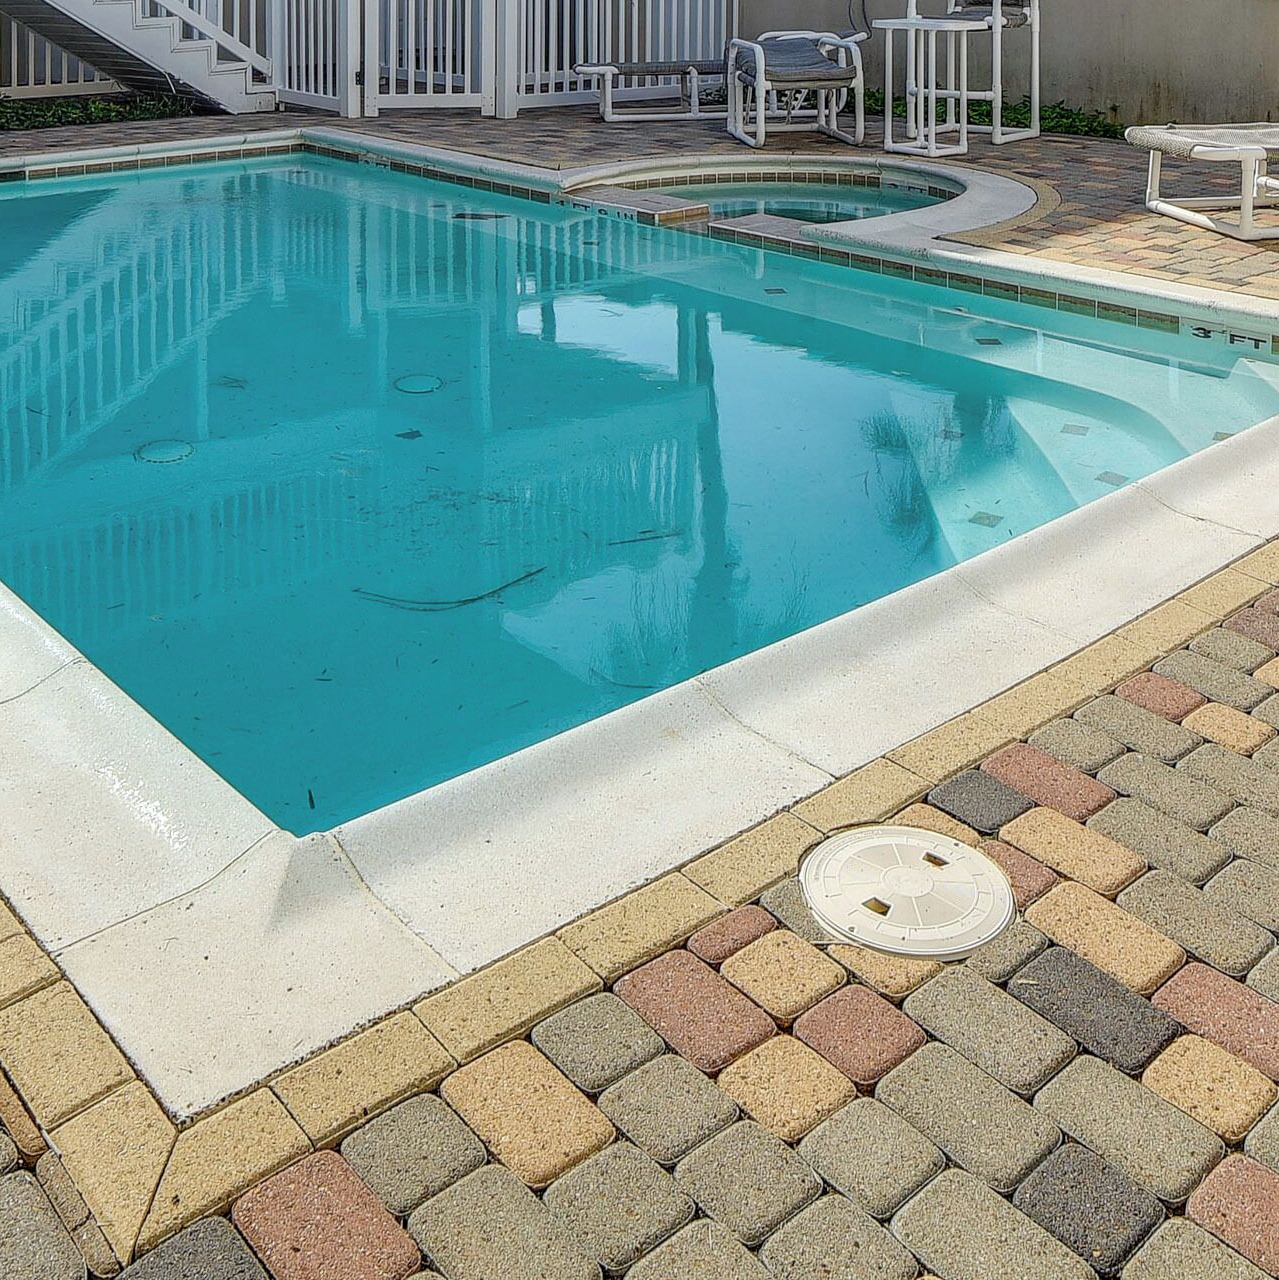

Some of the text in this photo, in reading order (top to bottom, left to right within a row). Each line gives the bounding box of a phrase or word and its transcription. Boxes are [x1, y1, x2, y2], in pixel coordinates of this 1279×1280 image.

[616, 211, 634, 221] IN
[1192, 327, 1267, 350] 3 FT
